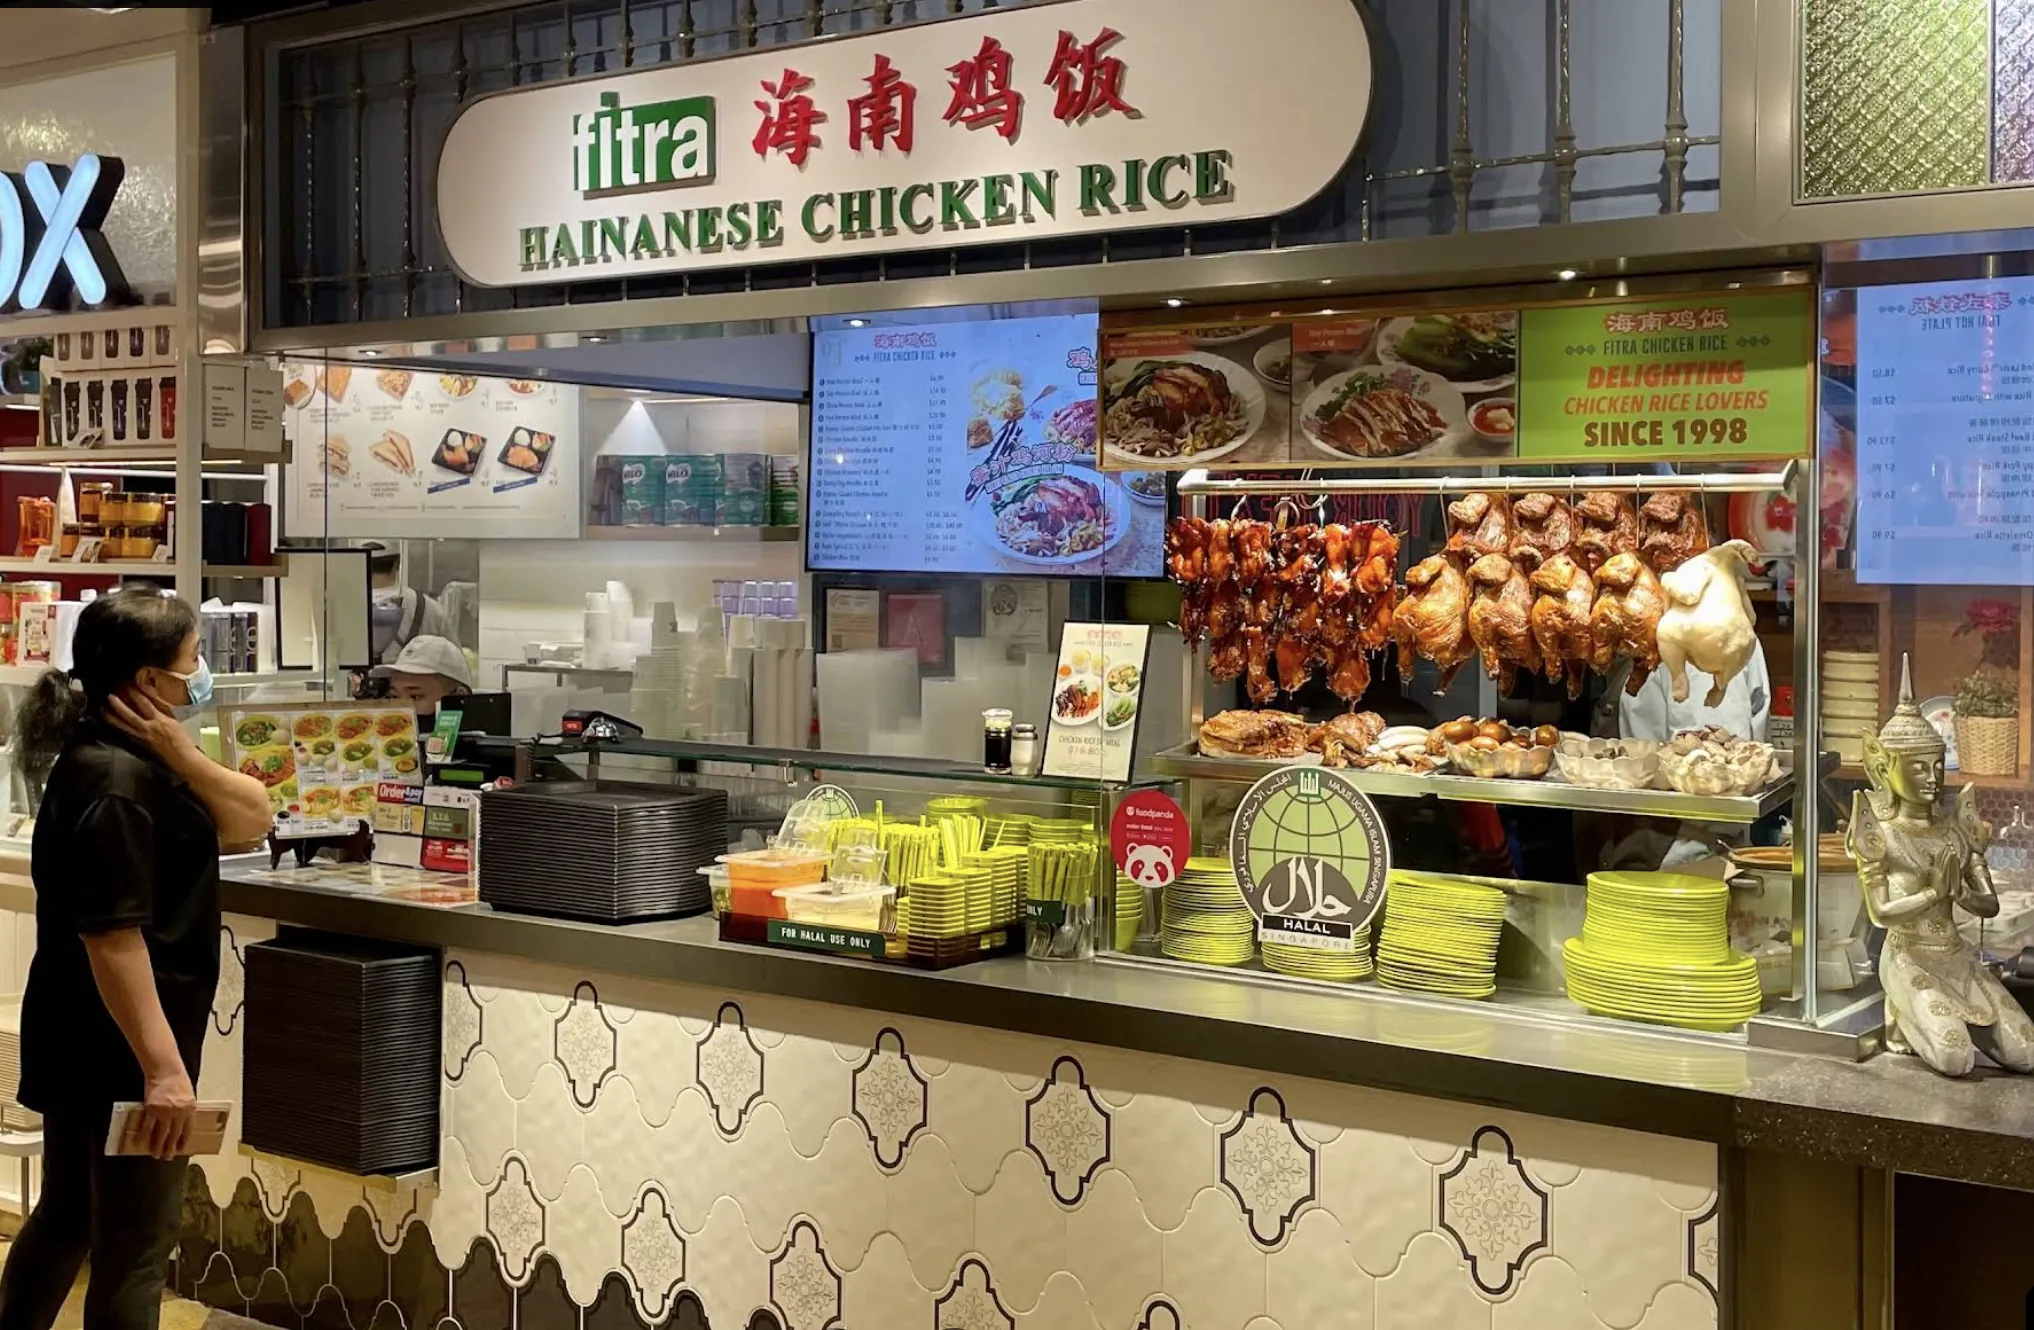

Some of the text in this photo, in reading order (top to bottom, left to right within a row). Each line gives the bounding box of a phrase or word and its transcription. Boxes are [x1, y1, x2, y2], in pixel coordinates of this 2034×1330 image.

[752, 27, 1141, 168] 海南鸡饭
[573, 92, 710, 192] fitra
[518, 149, 1233, 270] HAINANESE CHICKEN RICE
[1606, 308, 1730, 334] 海南鸡饭
[1604, 334, 1727, 356] FITRA CHICKEN RICE
[1587, 360, 1745, 389] DELIGHTING
[1564, 390, 1769, 415] CHICKEN RICE LOVERS
[1584, 418, 1748, 447] SINCE 1998
[1135, 803, 1174, 820] foodpanda
[1350, 797, 1374, 829] UGAMA
[1369, 829, 1382, 855] ISLAM
[1363, 856, 1383, 905] SINGAPURA
[781, 927, 871, 949] FOR HALAL USE ONLY
[1283, 918, 1331, 934] HALAL
[1261, 931, 1352, 950] SINGAPORE
